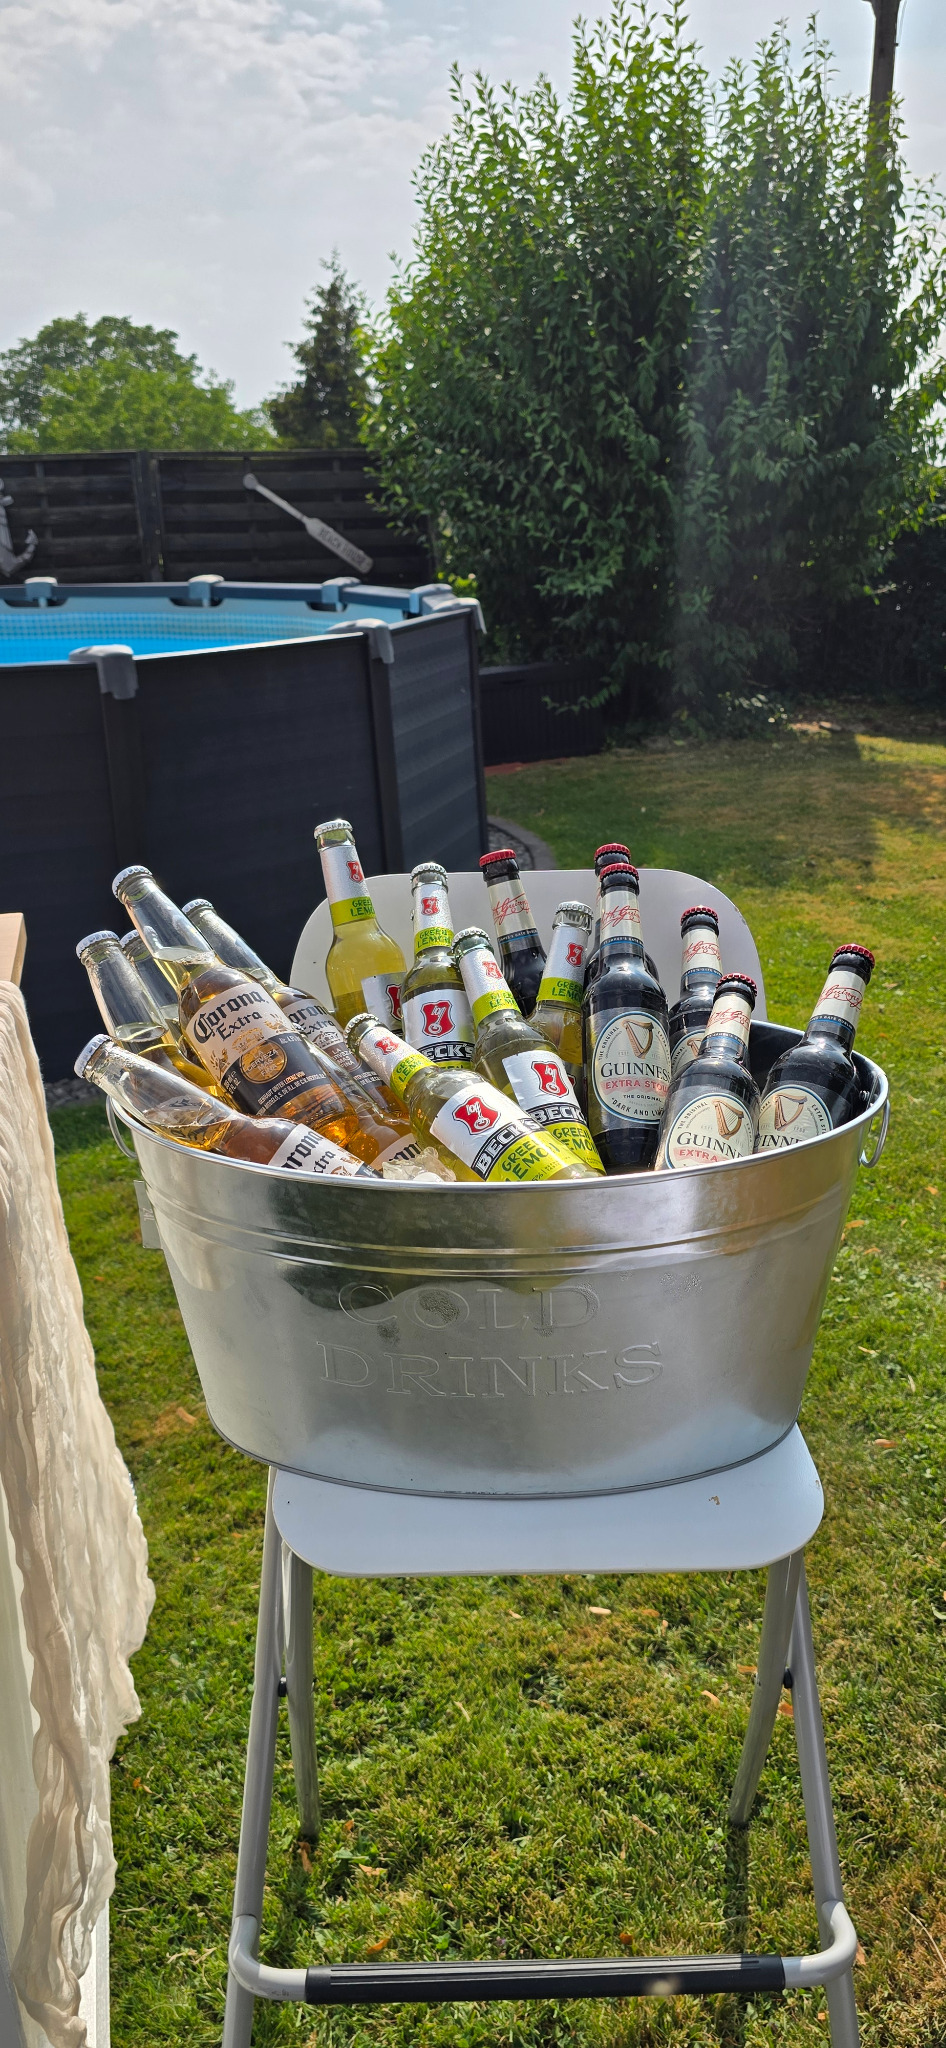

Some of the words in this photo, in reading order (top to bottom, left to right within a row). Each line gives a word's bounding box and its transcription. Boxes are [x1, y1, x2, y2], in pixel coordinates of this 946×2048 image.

[352, 899, 373, 908] GREE
[194, 990, 265, 1043] Corona
[216, 1011, 262, 1041] Extra
[602, 1026, 619, 1048] ORIGINAL
[421, 1044, 474, 1060] ECK'S
[604, 1080, 640, 1090] EXTRA
[644, 1080, 668, 1093] STOU
[812, 1104, 824, 1122] EXTRA
[314, 1150, 336, 1173] xtra
[680, 1150, 718, 1162] EXTRA
[338, 1283, 600, 1332] COLD
[316, 1341, 663, 1397] DRINKS
